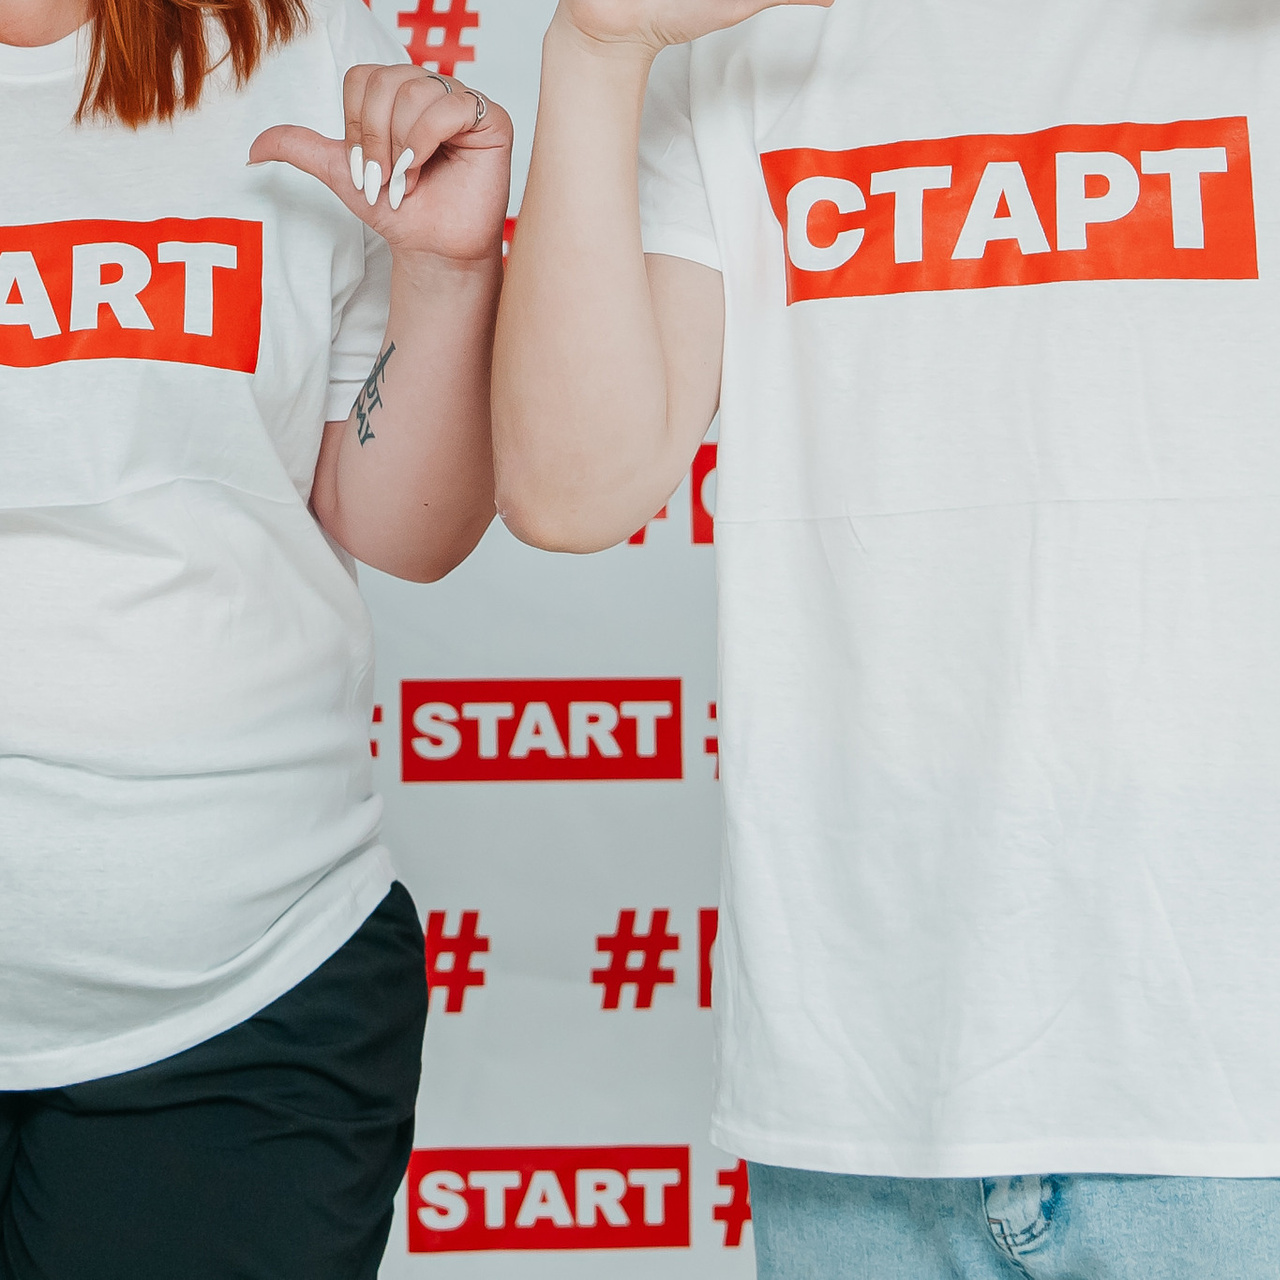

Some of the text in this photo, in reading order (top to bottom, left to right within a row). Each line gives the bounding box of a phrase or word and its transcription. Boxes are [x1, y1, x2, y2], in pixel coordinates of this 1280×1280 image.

[785, 146, 1228, 272] СТАРТ
[412, 701, 672, 760] START
[418, 1168, 681, 1230] START
